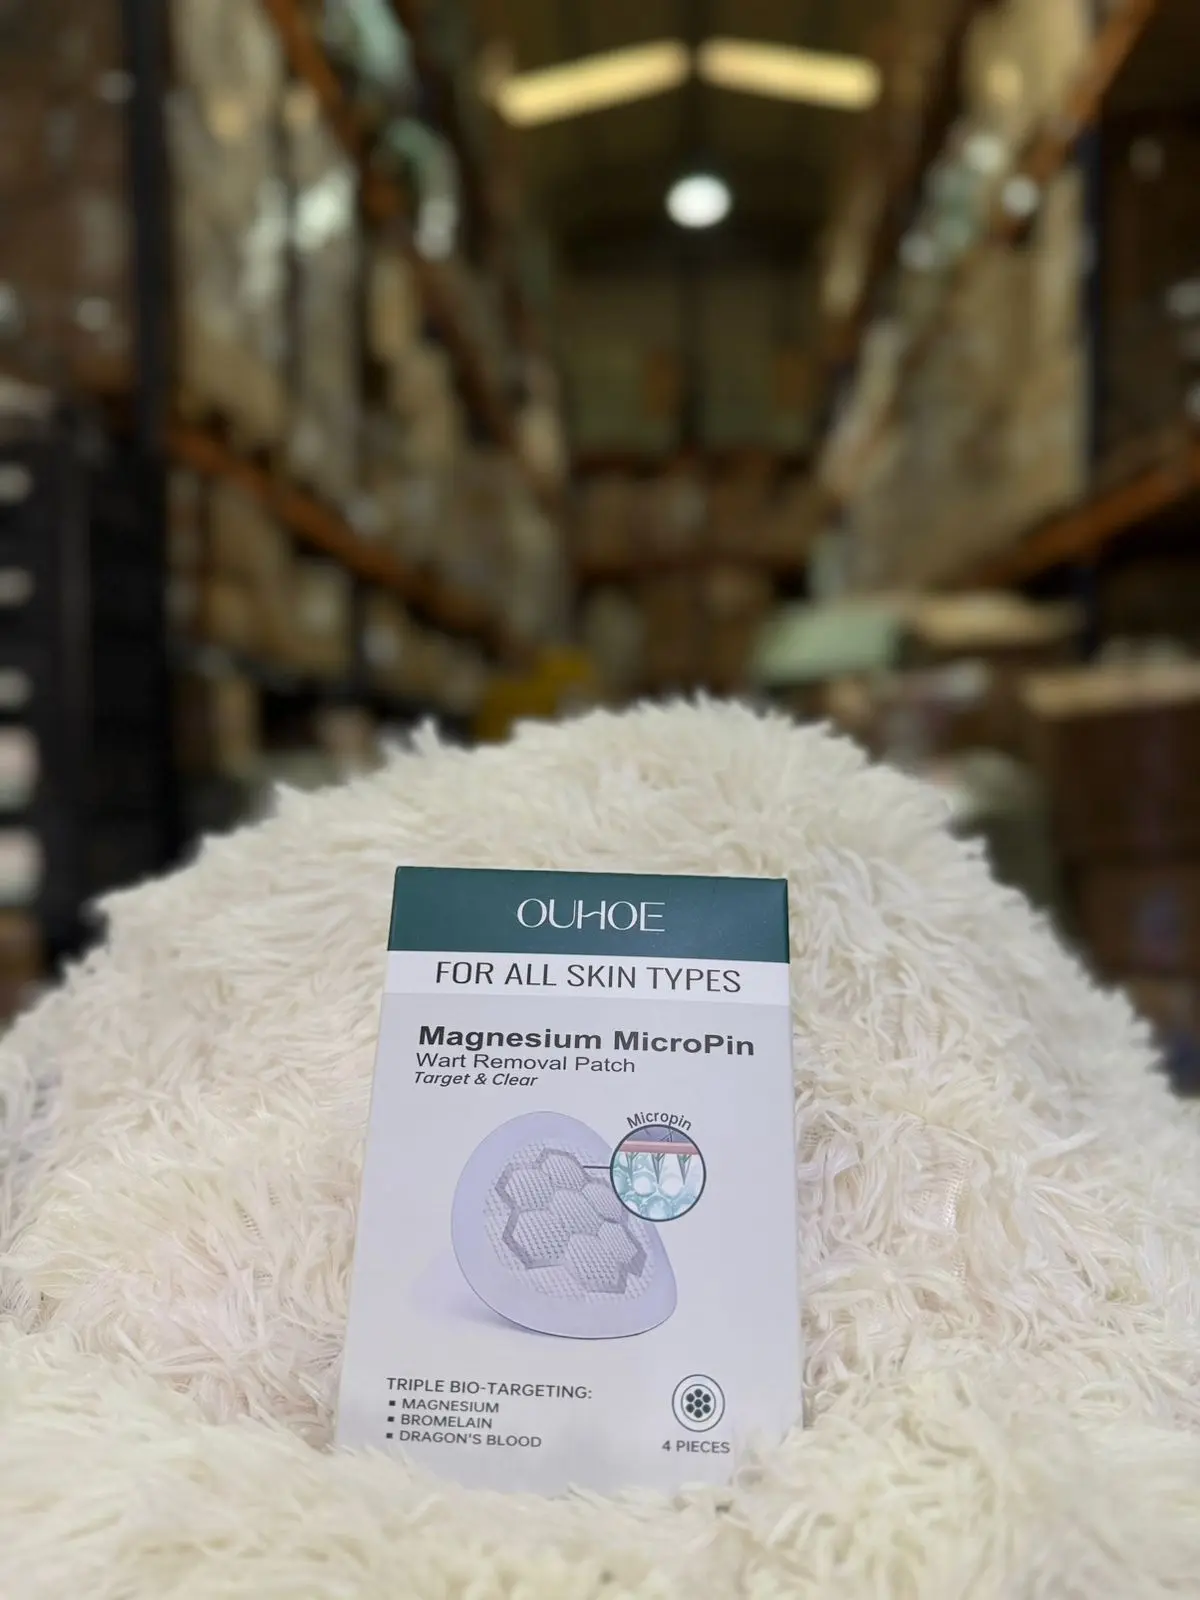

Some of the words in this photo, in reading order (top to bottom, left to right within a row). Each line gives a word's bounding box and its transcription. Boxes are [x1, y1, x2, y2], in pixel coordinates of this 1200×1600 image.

[517, 898, 665, 932] OUHOE
[436, 961, 494, 985] FOR
[504, 962, 557, 987] ALL
[567, 964, 636, 988] SKIN
[646, 966, 742, 993] TYPES
[418, 1025, 601, 1052] Magnesium
[613, 1030, 755, 1056] MicroPin
[416, 1052, 466, 1069] Wart
[473, 1053, 567, 1071] Removal
[575, 1056, 635, 1073] Patch
[414, 1071, 471, 1087] Target
[475, 1072, 487, 1085] &
[492, 1072, 538, 1087] Clear
[626, 1111, 692, 1131] Micropin
[387, 1377, 445, 1394] TRIPLE
[449, 1380, 592, 1400] BIO-TARGETING:
[401, 1398, 500, 1413] MAGNESIUM
[400, 1413, 493, 1429] BROMELAIN
[399, 1430, 482, 1446] DRAGON'S
[486, 1433, 542, 1448] BLOOD
[662, 1440, 672, 1453] 4
[676, 1440, 730, 1454] PIECES
